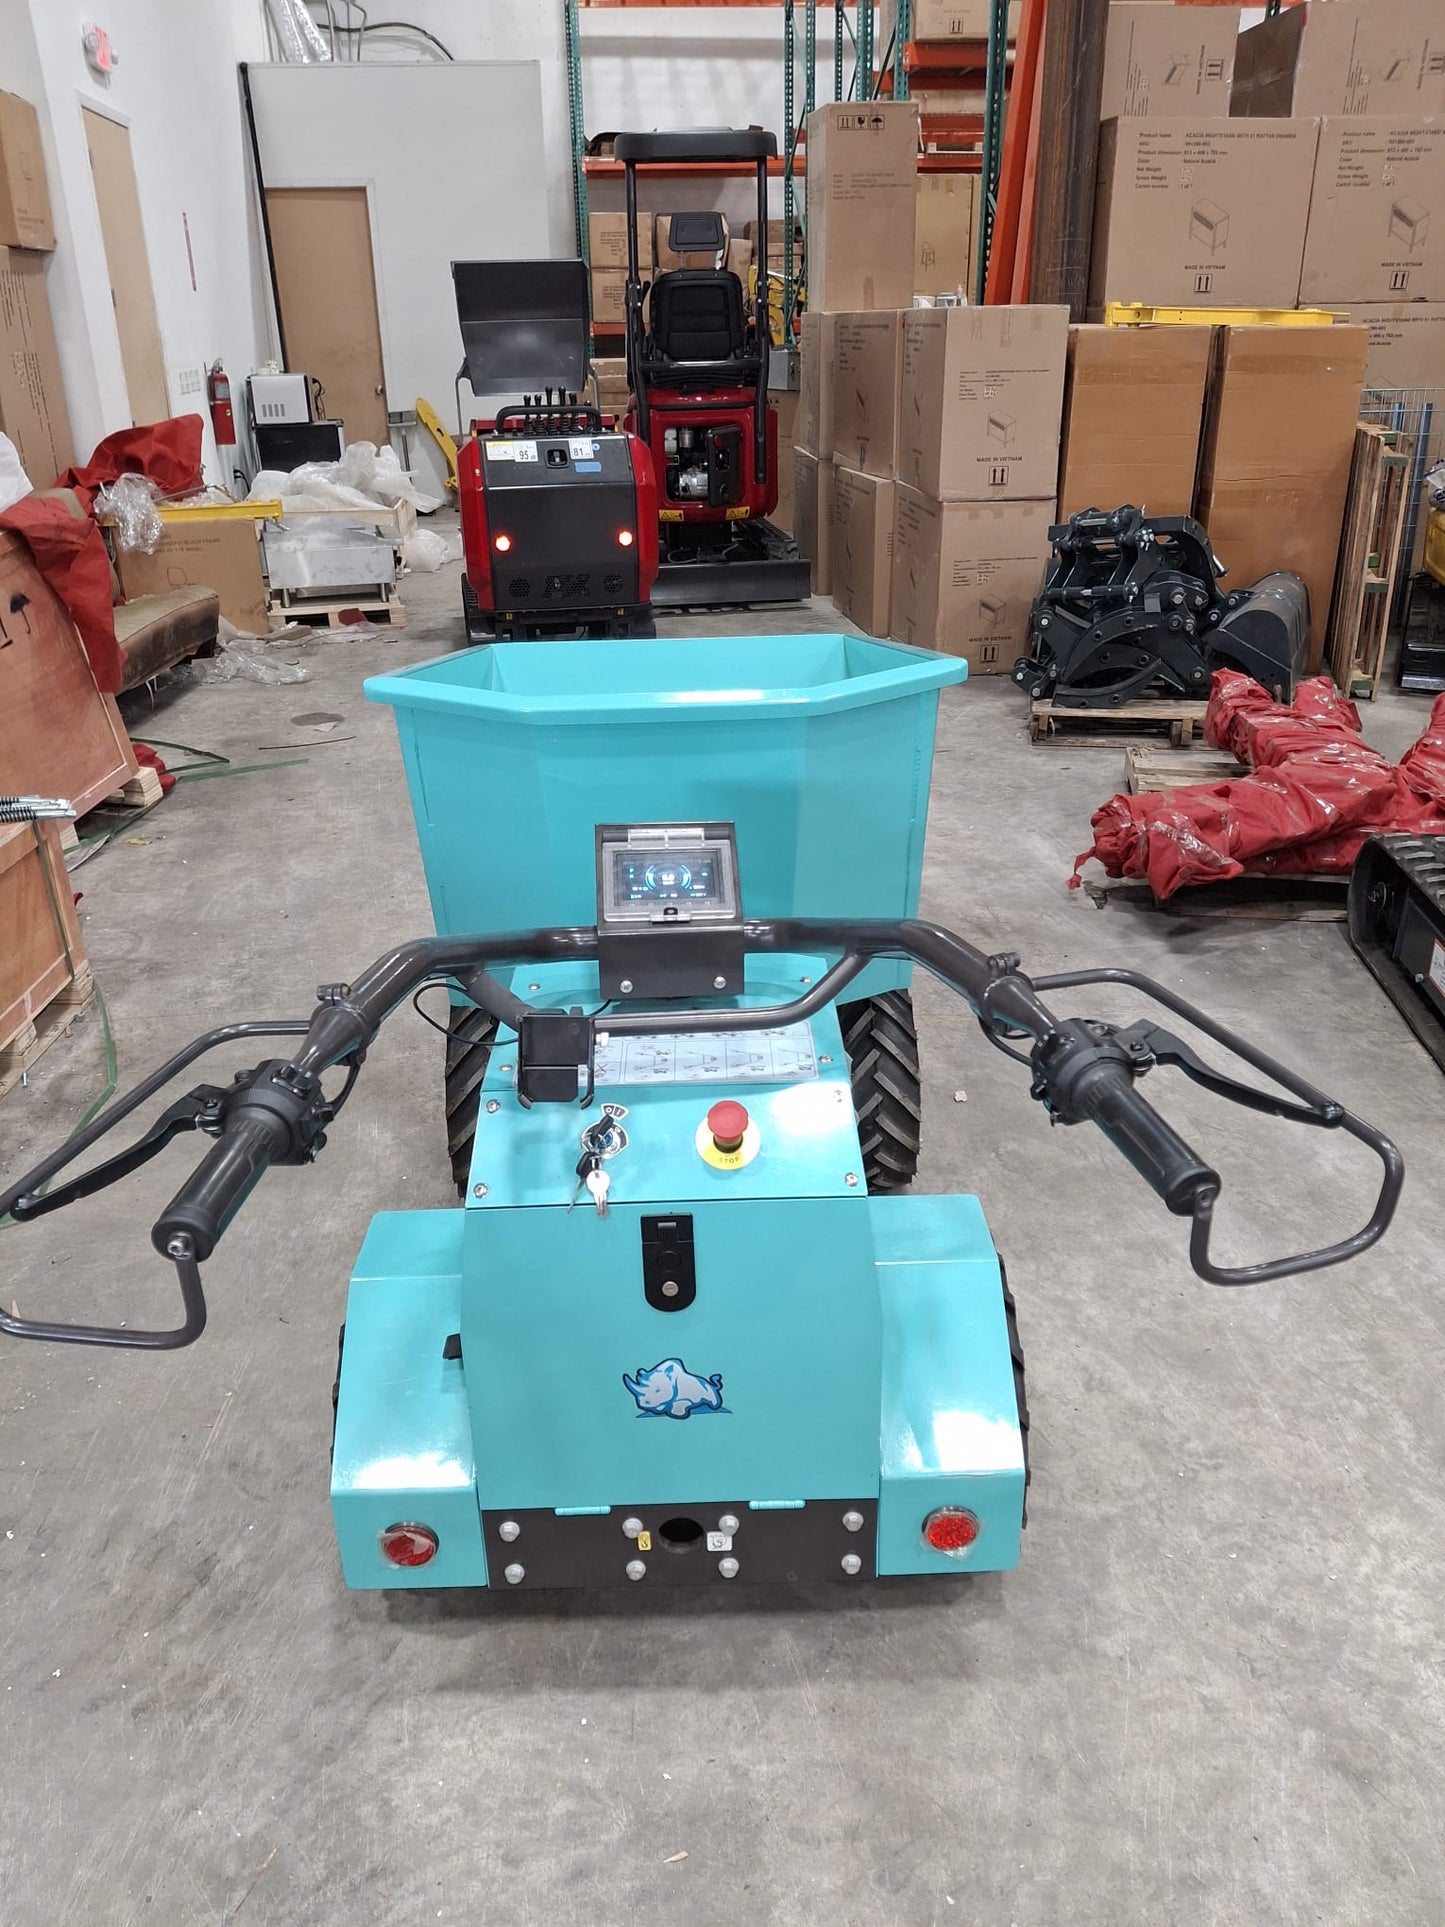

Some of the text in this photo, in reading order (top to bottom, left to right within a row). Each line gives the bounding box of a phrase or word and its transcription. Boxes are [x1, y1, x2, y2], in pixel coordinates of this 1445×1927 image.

[519, 450, 529, 460] 95
[573, 447, 584, 457] 81
[718, 1156, 741, 1164] STOP
